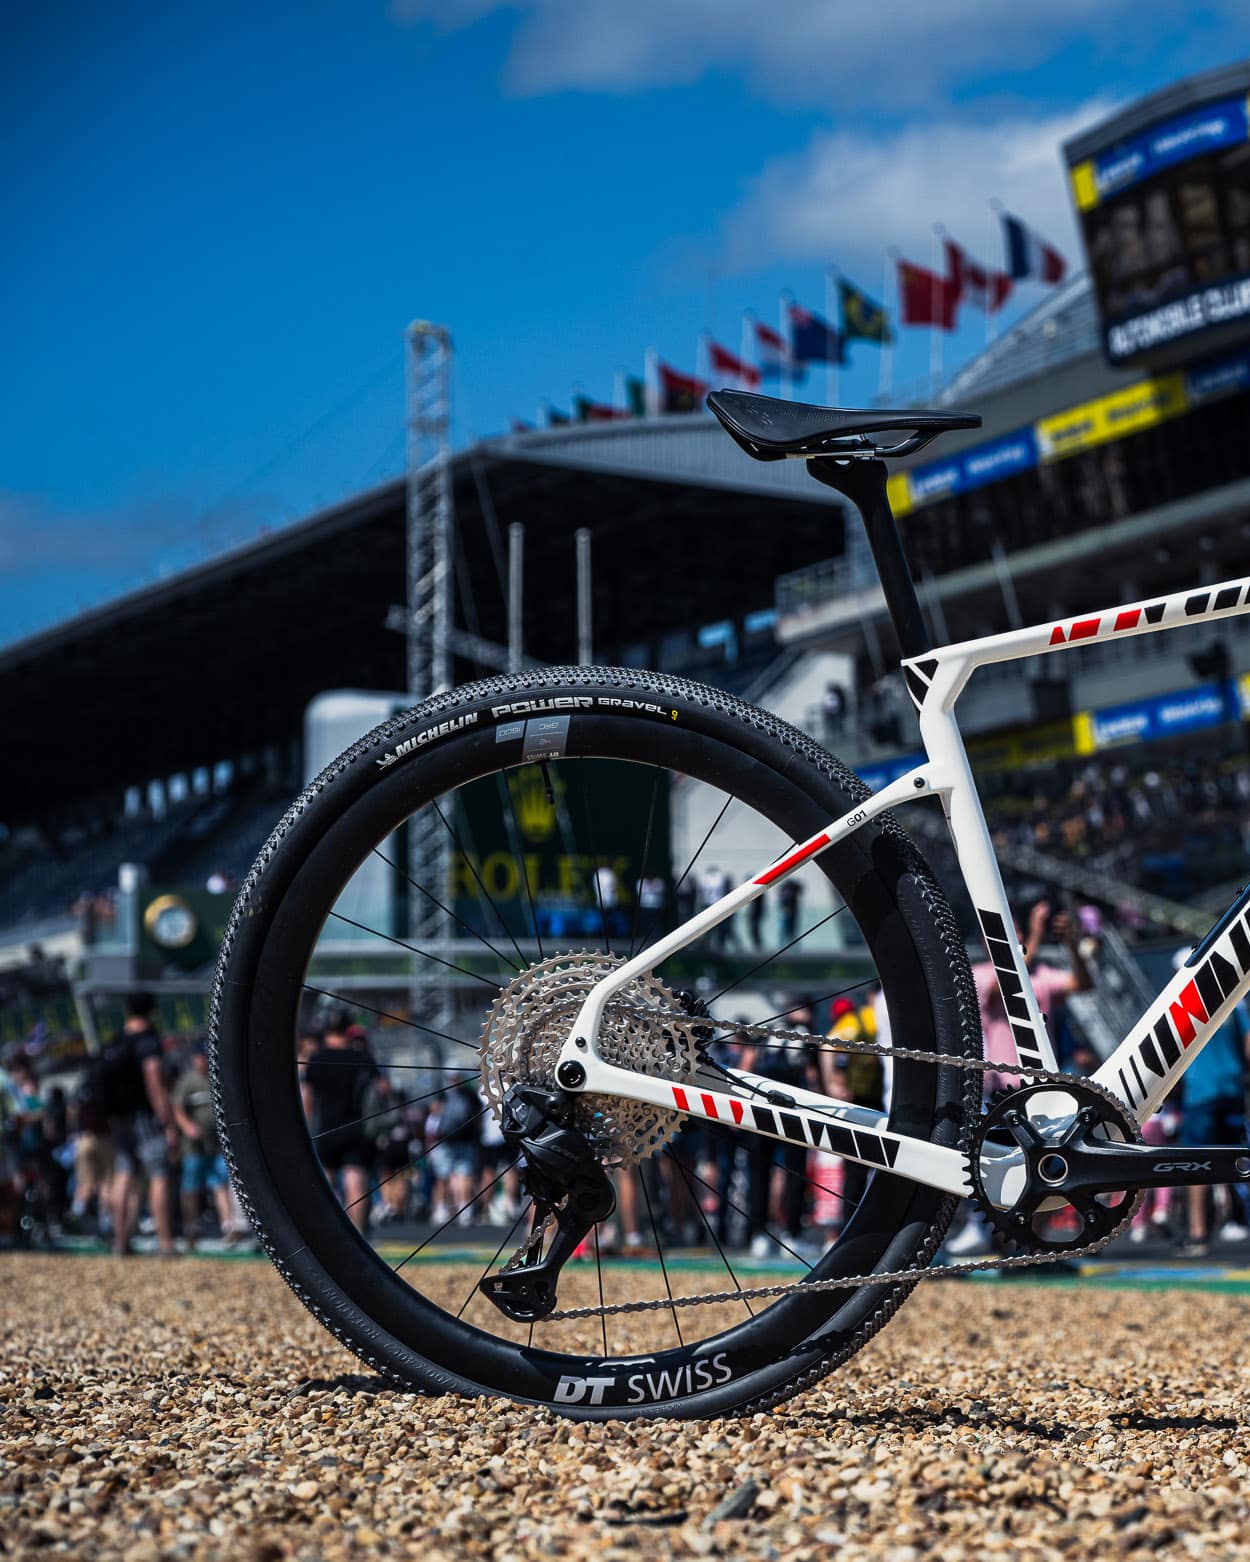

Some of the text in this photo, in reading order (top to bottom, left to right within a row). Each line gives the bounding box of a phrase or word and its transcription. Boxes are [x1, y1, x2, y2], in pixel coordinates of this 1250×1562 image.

[395, 711, 479, 754] MICHELIN
[490, 696, 594, 718] POWER
[847, 810, 867, 827] G01
[1153, 1161, 1212, 1172] GRX
[553, 1352, 732, 1405] DT SWISS
